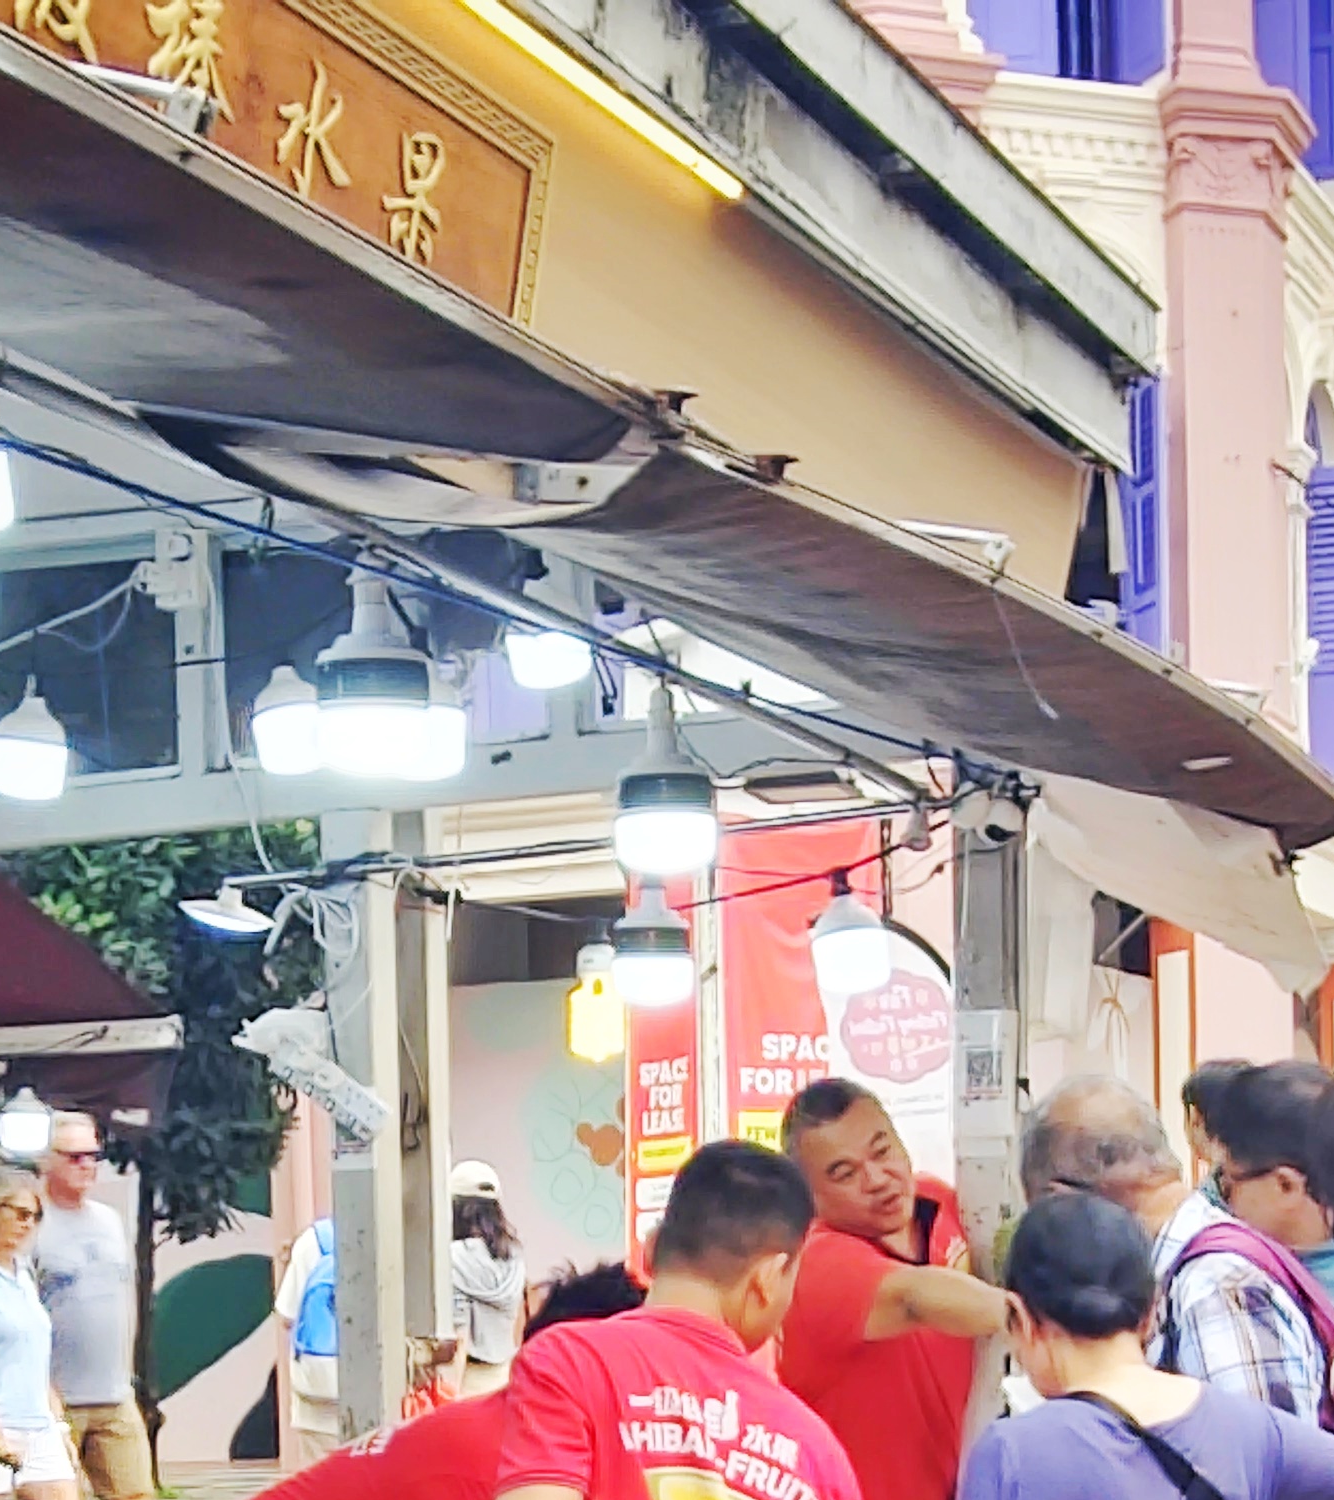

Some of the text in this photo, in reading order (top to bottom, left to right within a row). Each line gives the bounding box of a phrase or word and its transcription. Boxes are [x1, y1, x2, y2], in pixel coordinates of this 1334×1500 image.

[761, 1032, 830, 1061] SPAC
[740, 1066, 793, 1095] FOR
[648, 1082, 683, 1110] FOR
